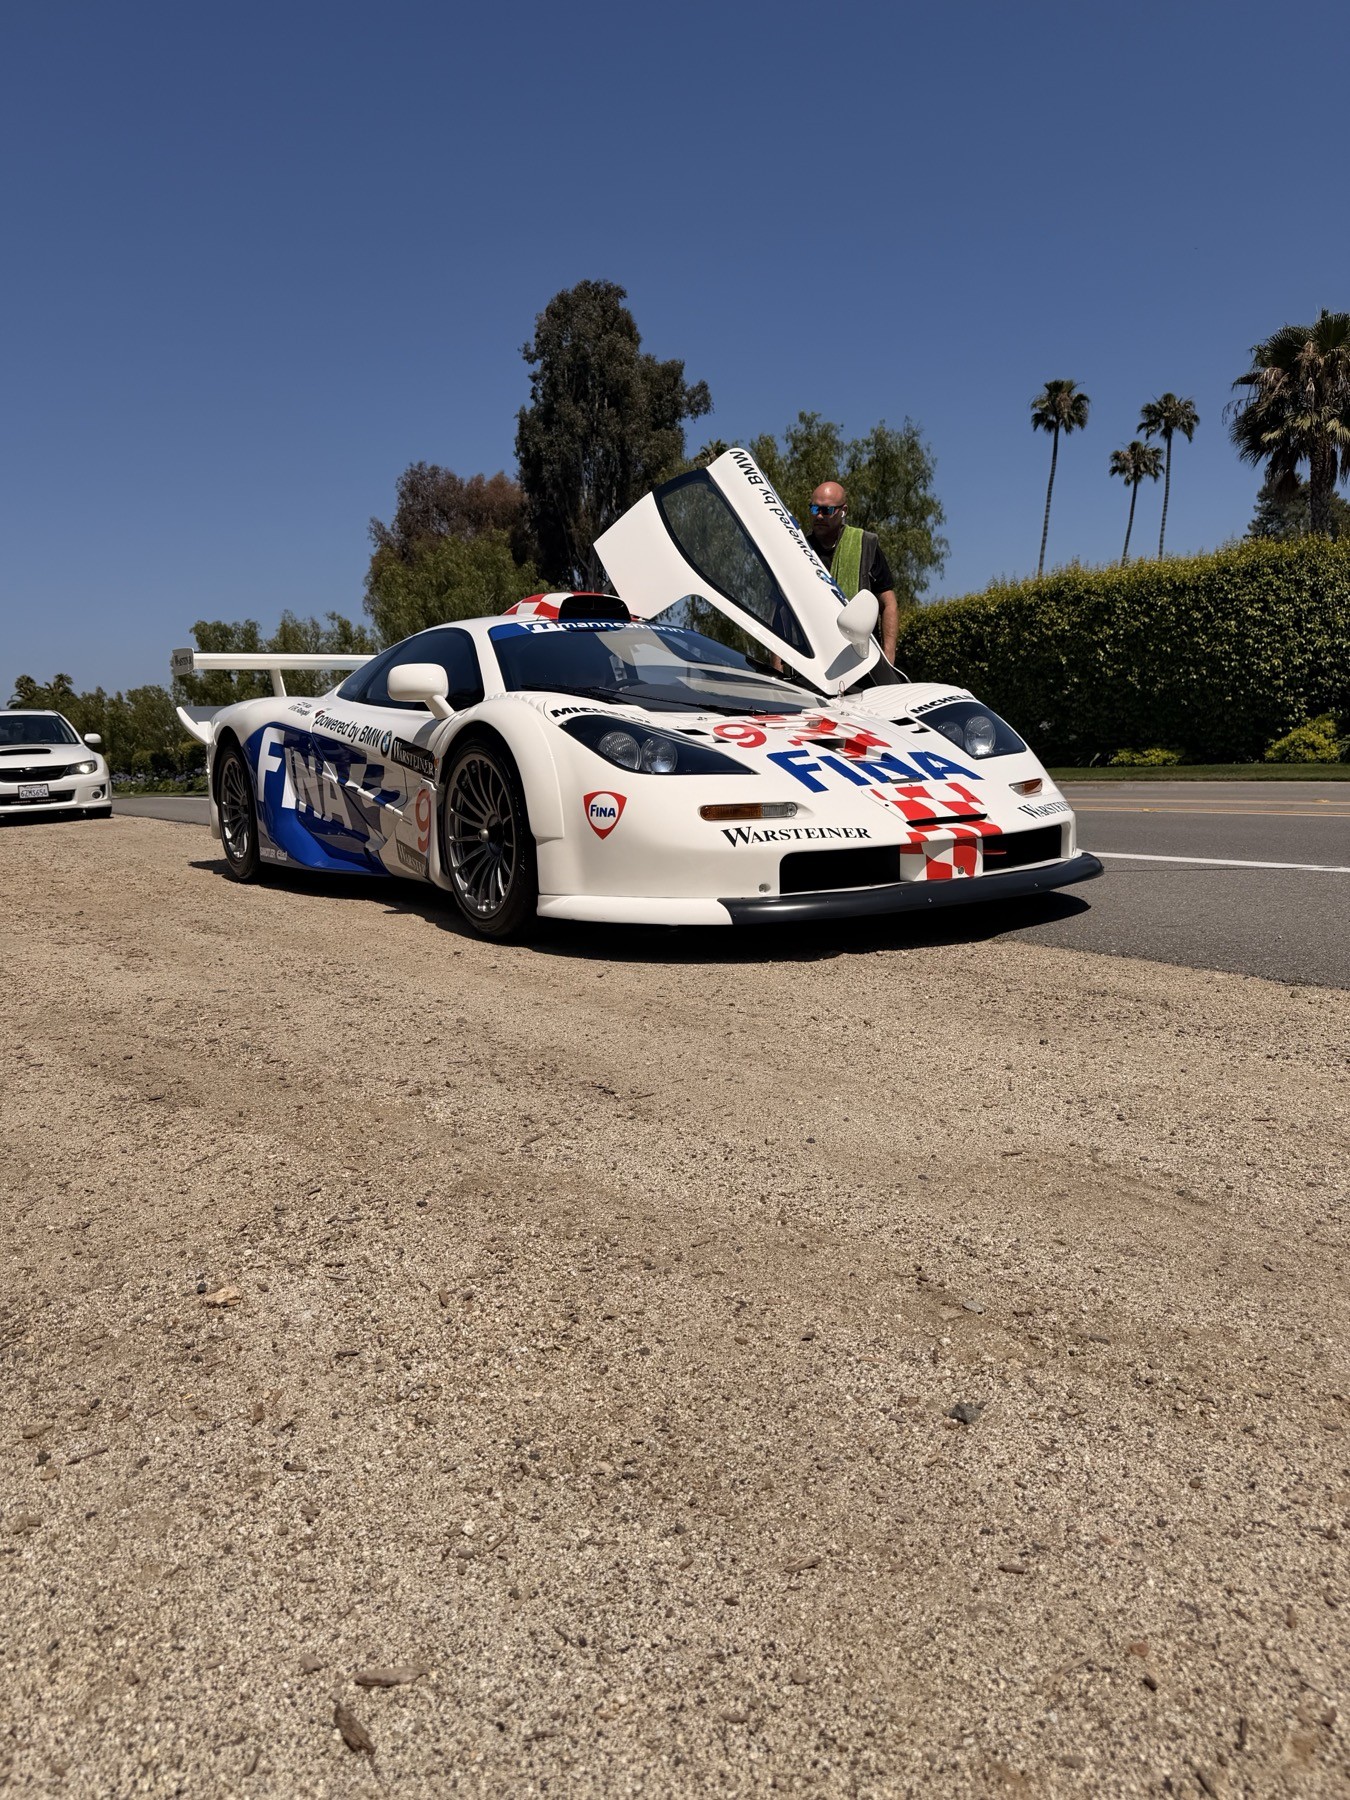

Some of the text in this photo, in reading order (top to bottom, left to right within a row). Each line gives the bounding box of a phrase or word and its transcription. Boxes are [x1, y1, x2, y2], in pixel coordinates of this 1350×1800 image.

[730, 450, 821, 567] powered by BMW
[560, 621, 684, 634] mannesmann
[313, 714, 385, 748] powered by BMW
[713, 723, 767, 748] 9
[257, 726, 353, 831] FINA
[766, 749, 985, 793] FINA
[415, 788, 432, 853] 9
[590, 804, 617, 818] FINA
[721, 826, 872, 848] WARSTEINER
